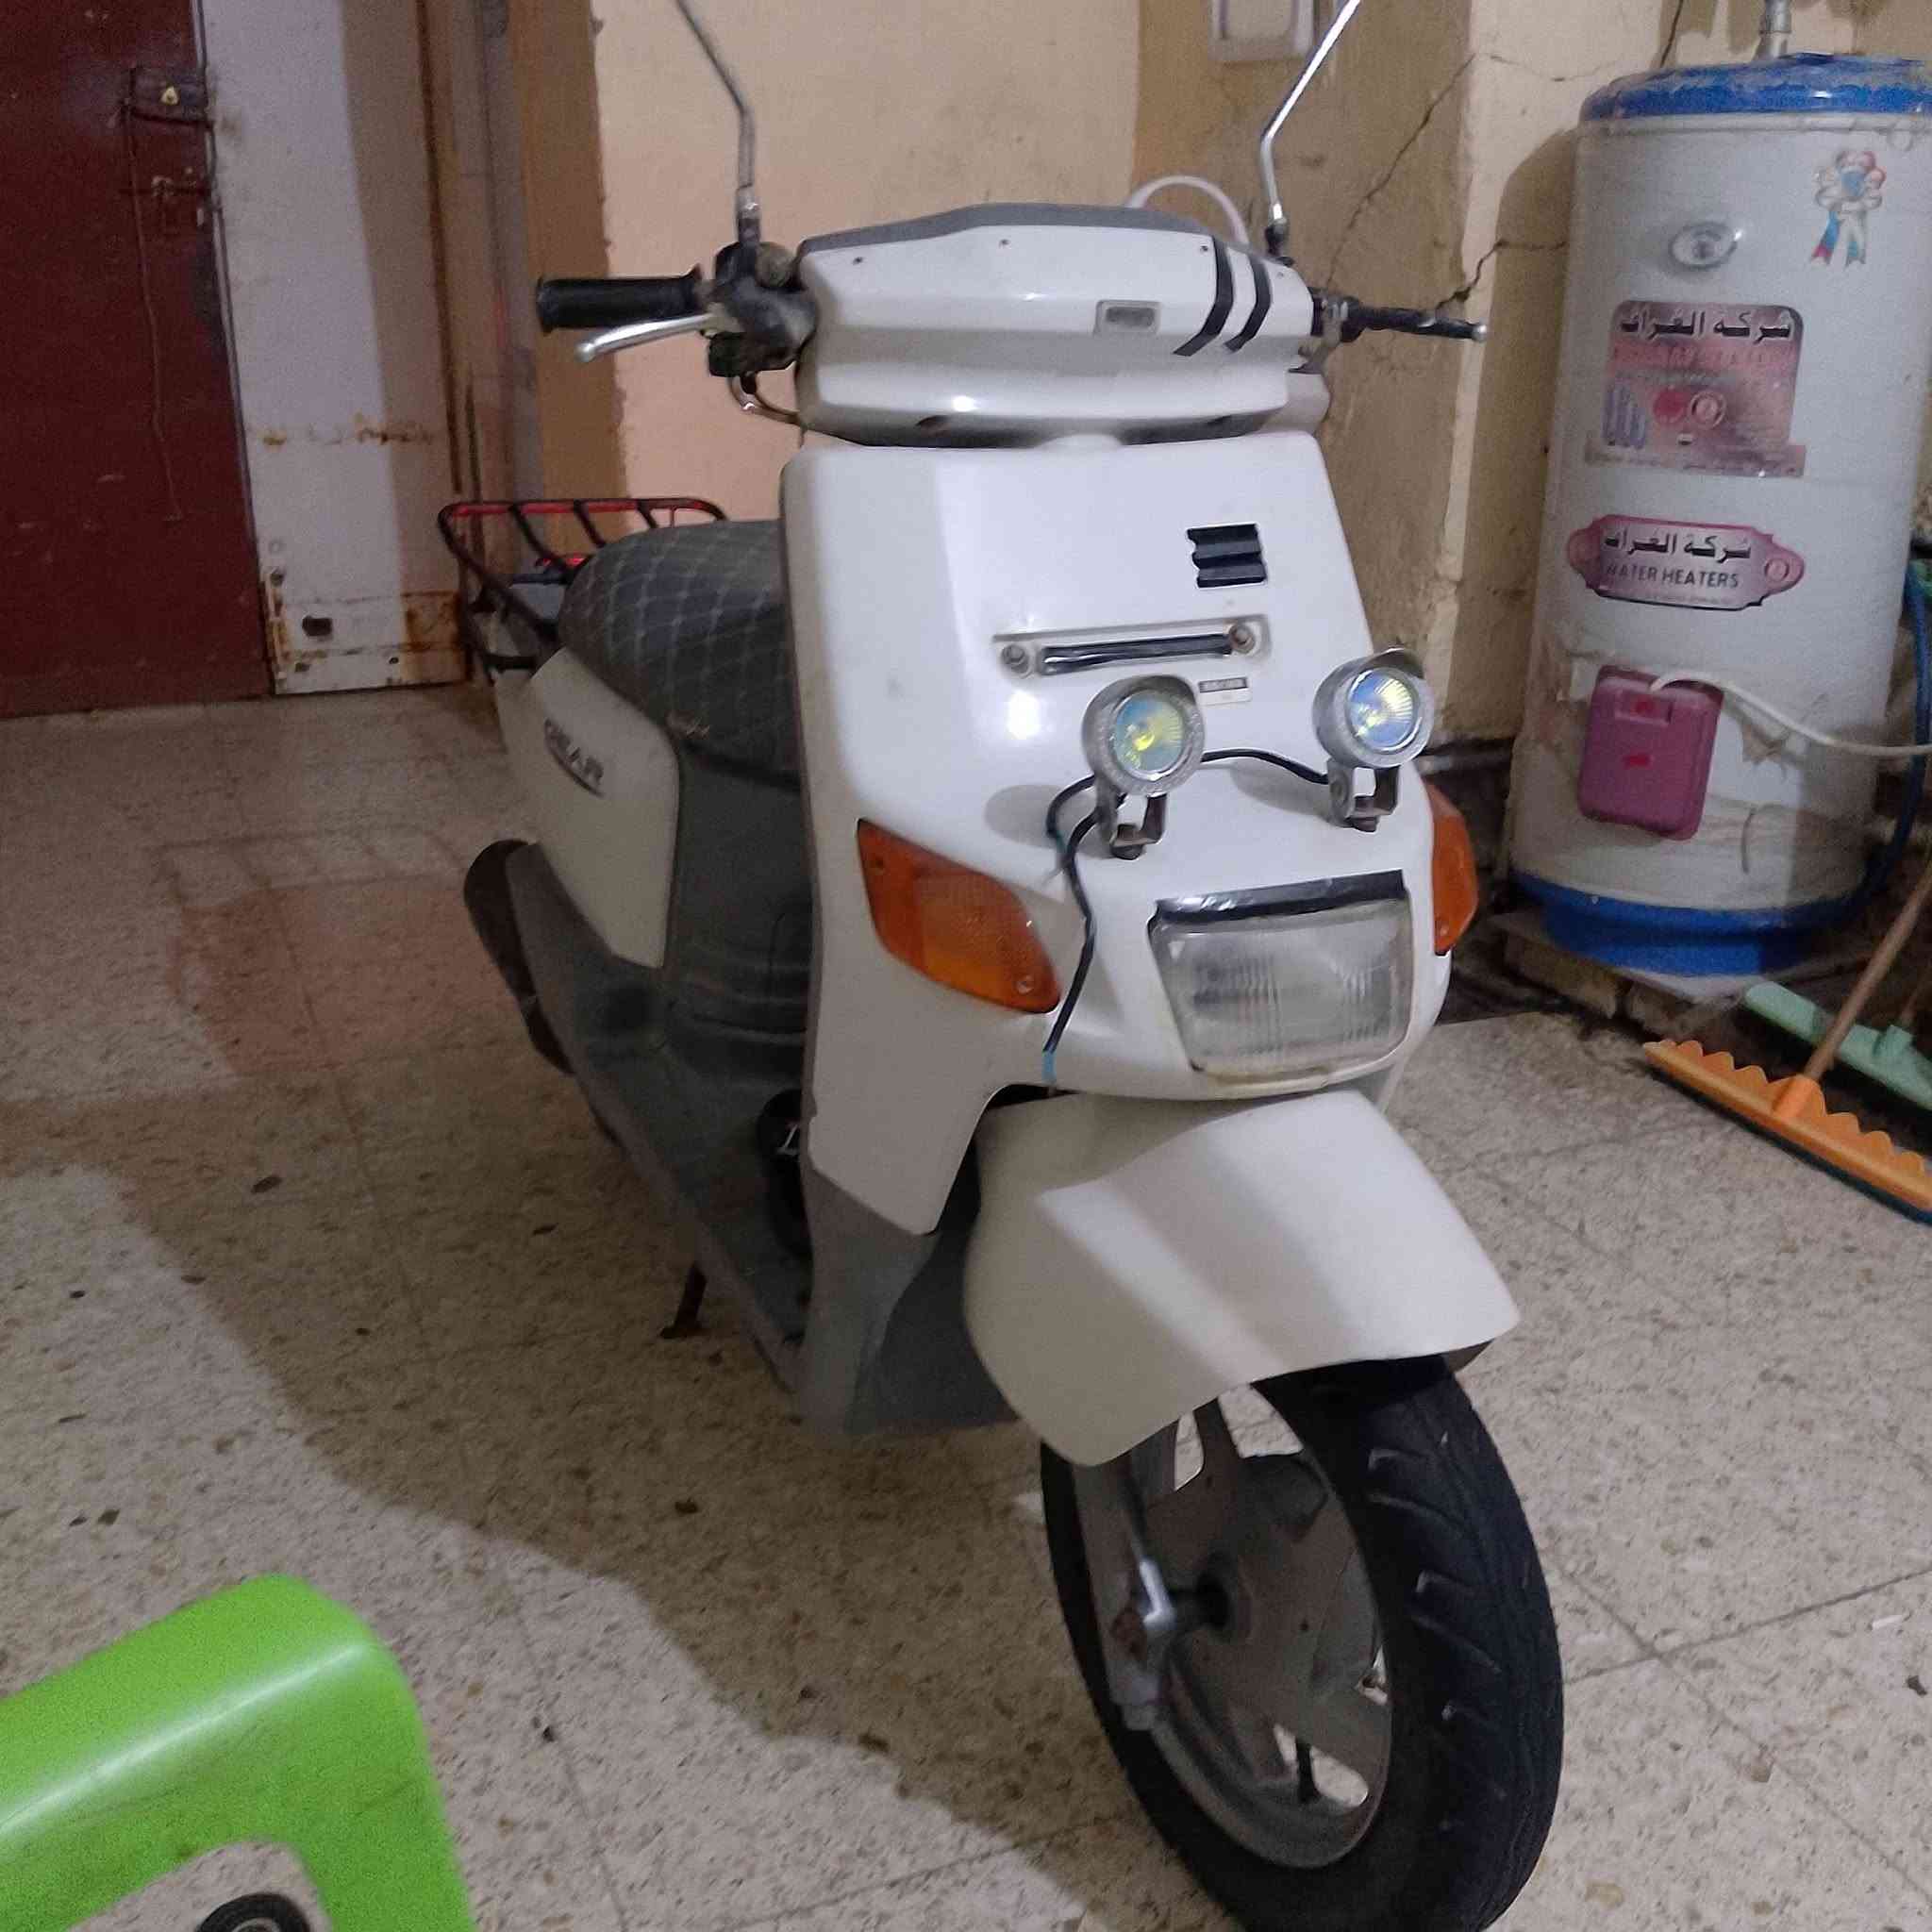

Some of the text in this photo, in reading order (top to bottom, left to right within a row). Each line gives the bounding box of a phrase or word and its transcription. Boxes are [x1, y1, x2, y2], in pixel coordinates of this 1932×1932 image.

[1712, 308, 1791, 345] شركة
[1684, 530, 1752, 564] شركة
[1662, 569, 1740, 589] HEATERS
